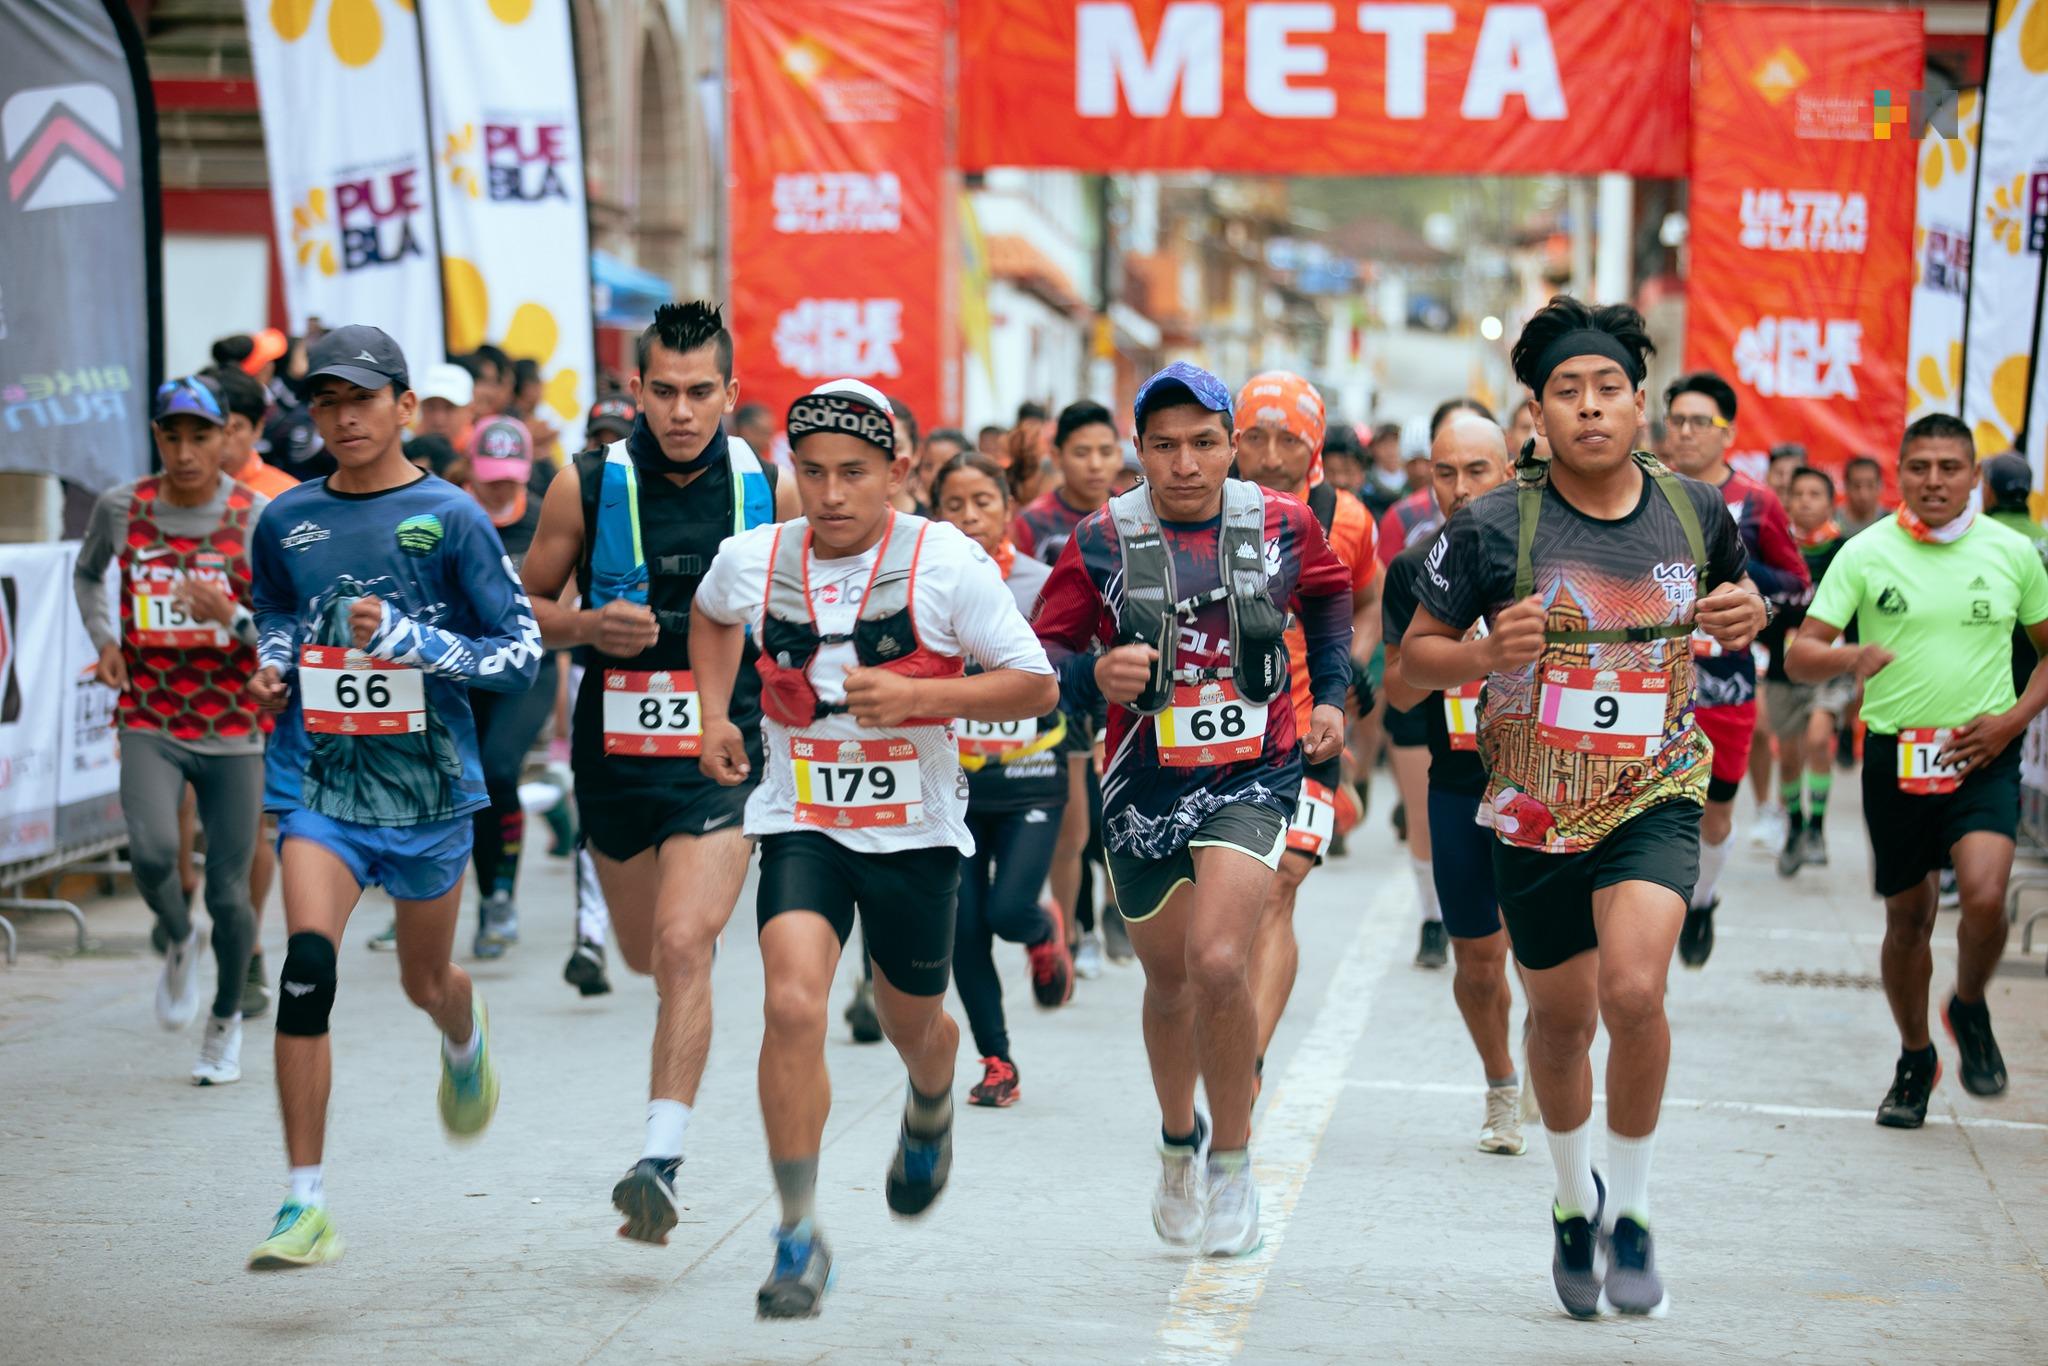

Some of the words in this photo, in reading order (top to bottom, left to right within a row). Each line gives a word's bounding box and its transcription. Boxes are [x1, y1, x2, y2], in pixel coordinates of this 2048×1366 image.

[1074, 2, 1568, 119] META
[484, 124, 566, 164] PUE
[335, 168, 421, 226] PUE
[487, 163, 570, 202] BLA
[1740, 188, 1867, 231] ULTRA
[342, 218, 423, 272] BLA
[336, 673, 391, 709] 66
[639, 698, 690, 729] 83
[1190, 704, 1246, 741] 68
[1593, 695, 1619, 729] 9
[817, 766, 896, 802] 179
